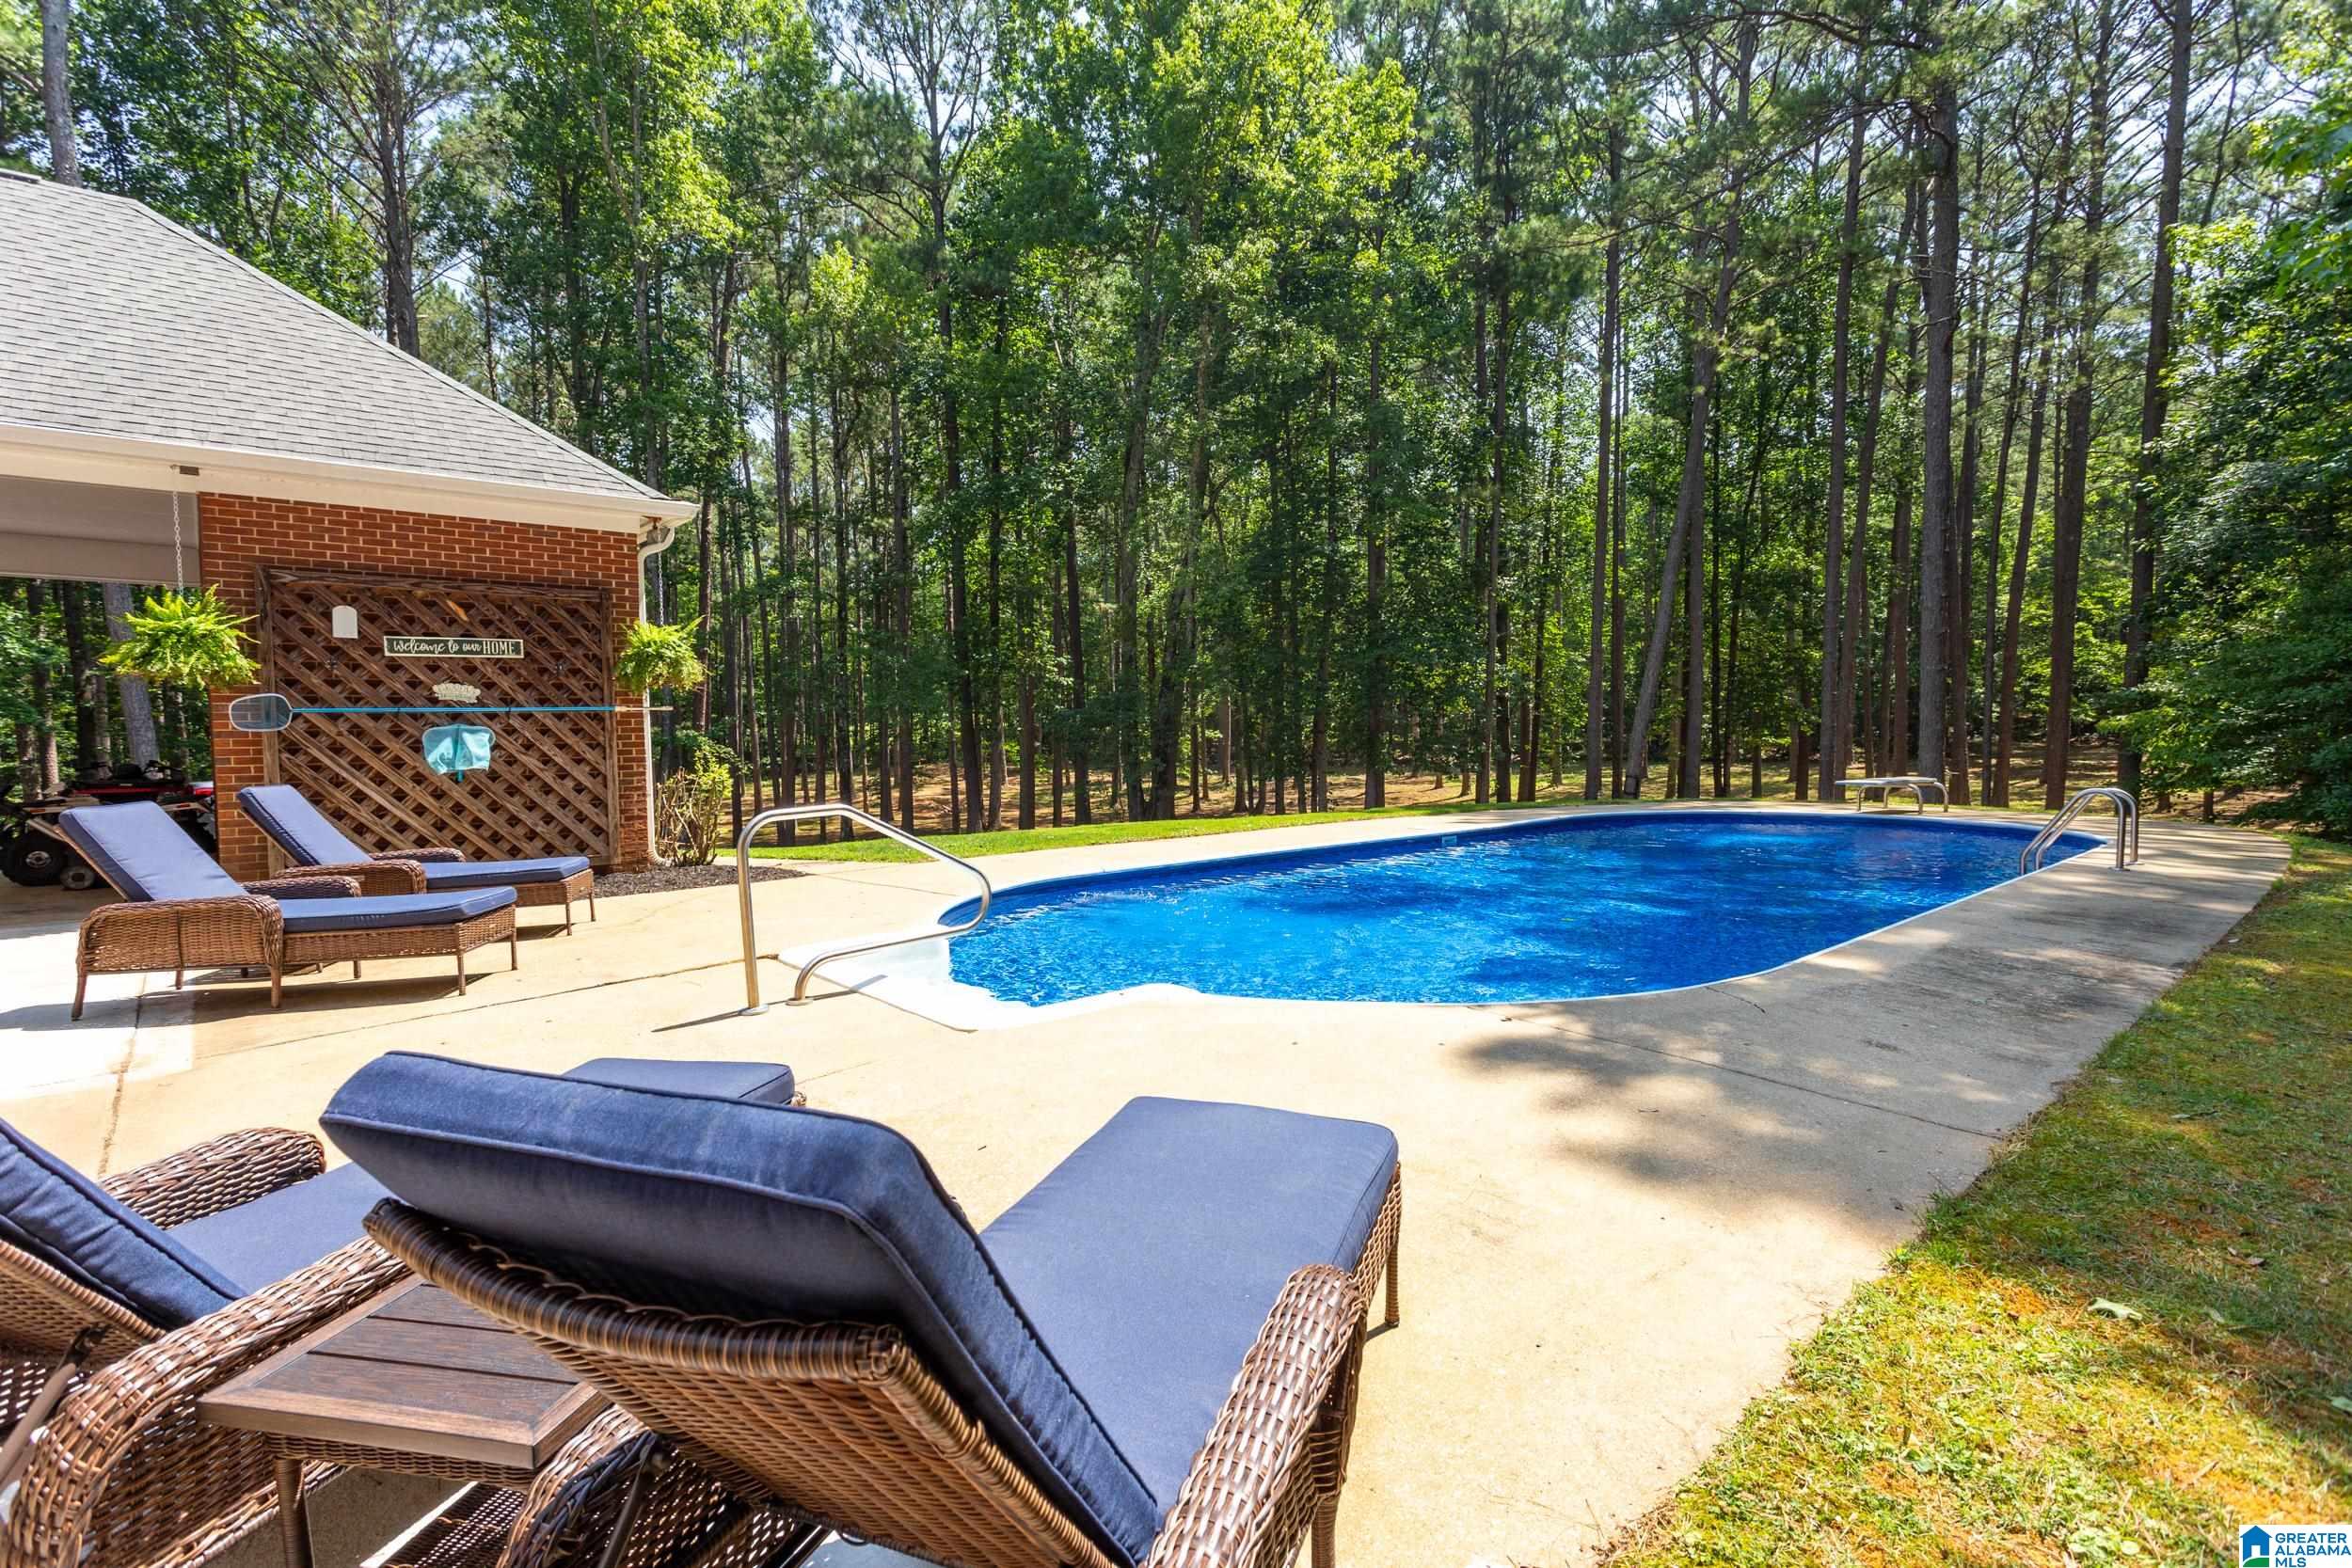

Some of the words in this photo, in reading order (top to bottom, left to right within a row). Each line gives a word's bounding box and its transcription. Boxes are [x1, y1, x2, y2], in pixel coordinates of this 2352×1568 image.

[448, 639, 459, 653] to
[462, 642, 482, 652] our
[483, 640, 516, 655] HOME
